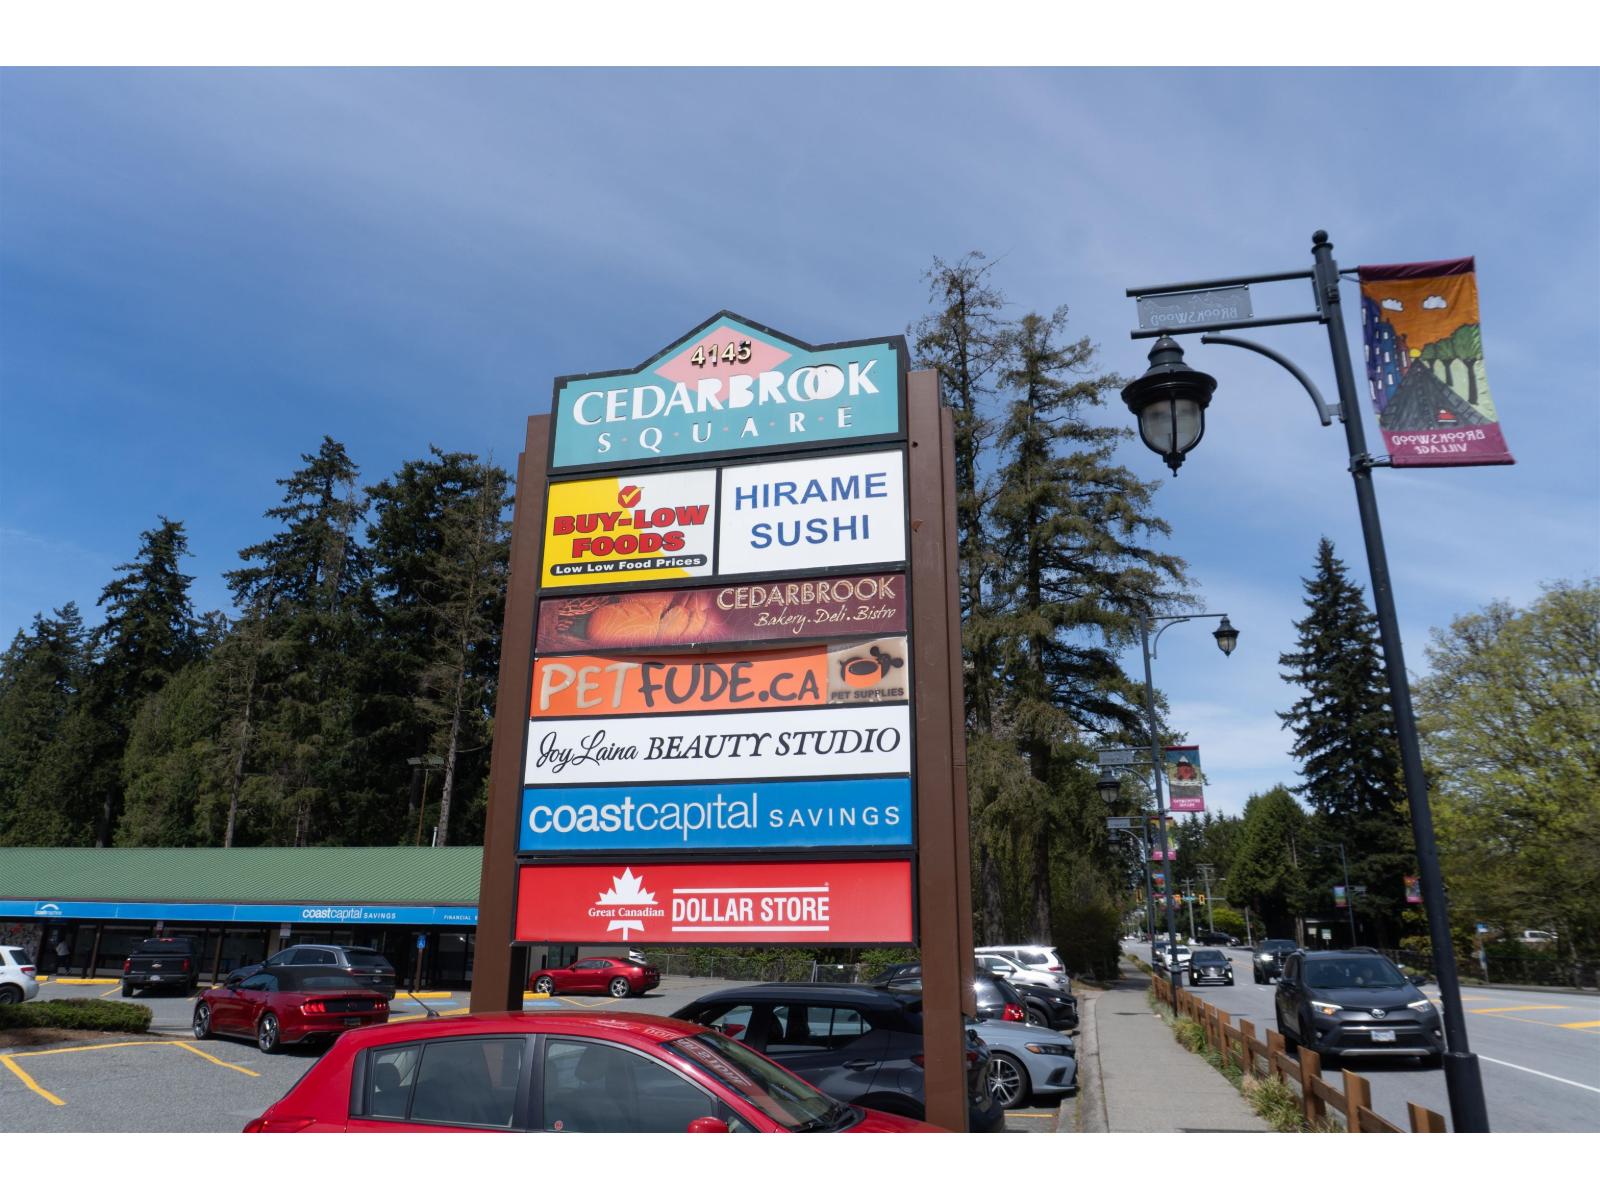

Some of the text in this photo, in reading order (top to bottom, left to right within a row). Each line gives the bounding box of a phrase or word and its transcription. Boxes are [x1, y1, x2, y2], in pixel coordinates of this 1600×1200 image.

[691, 339, 752, 365] 4145
[572, 358, 880, 426] CEDARBROOK
[735, 472, 888, 510] HIRAME
[553, 504, 709, 536] BUY-LOW
[750, 514, 870, 549] SUSHI
[572, 530, 685, 558] FOODS
[555, 557, 701, 574] Low Low Food Prices
[716, 576, 896, 611] CEDARBROOK
[853, 603, 896, 621] Bistro
[831, 688, 904, 700] PET SUPPLIES
[644, 733, 772, 760] BEAUTY
[775, 727, 901, 756] STUDIO
[769, 805, 900, 828] SAVINGS
[588, 907, 664, 917] Great Canadian
[672, 897, 829, 921] DOLLAR STORE
